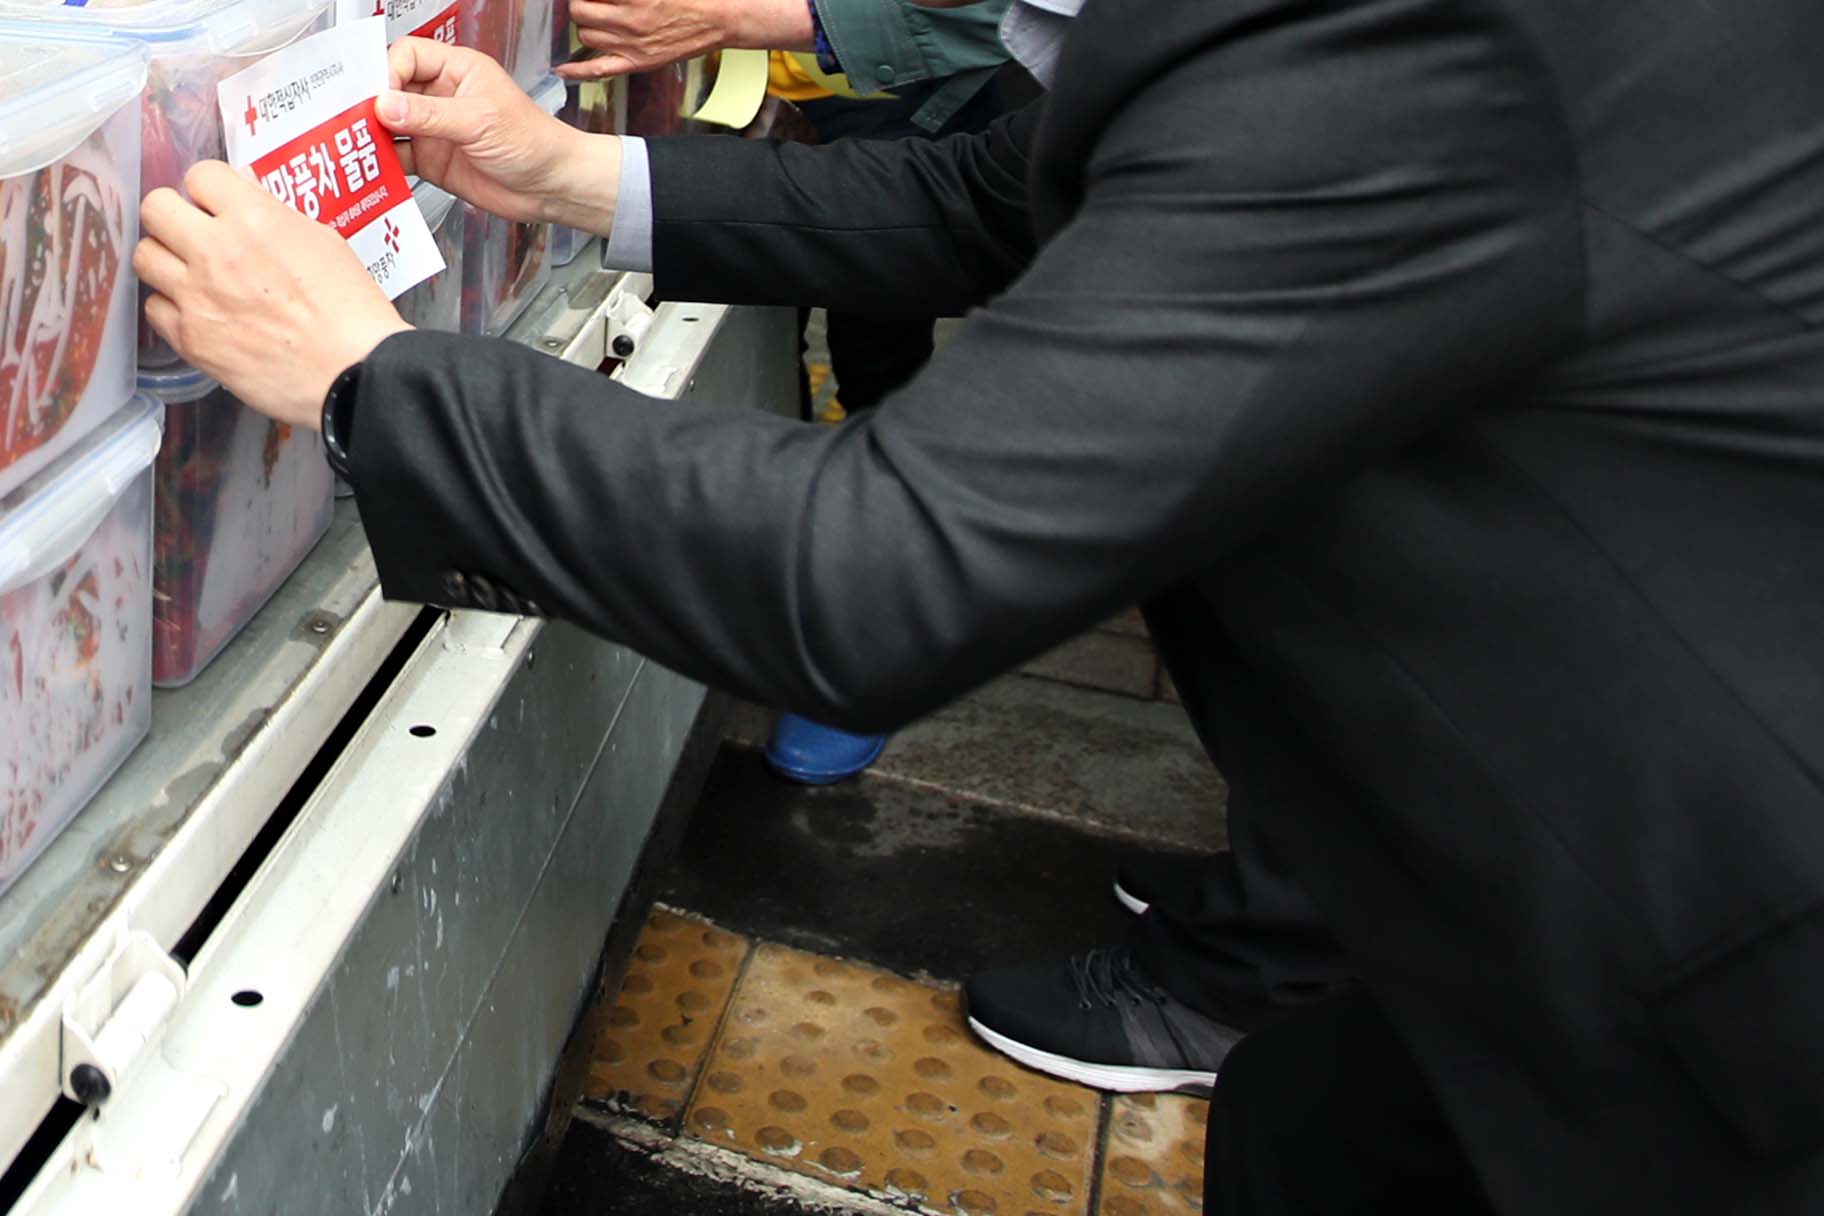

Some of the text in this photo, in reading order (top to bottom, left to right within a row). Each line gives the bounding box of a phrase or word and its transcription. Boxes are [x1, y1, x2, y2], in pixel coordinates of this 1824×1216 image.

[259, 77, 311, 122] 대한적십자사
[261, 142, 341, 221] 망풍차
[334, 118, 381, 194] 물품
